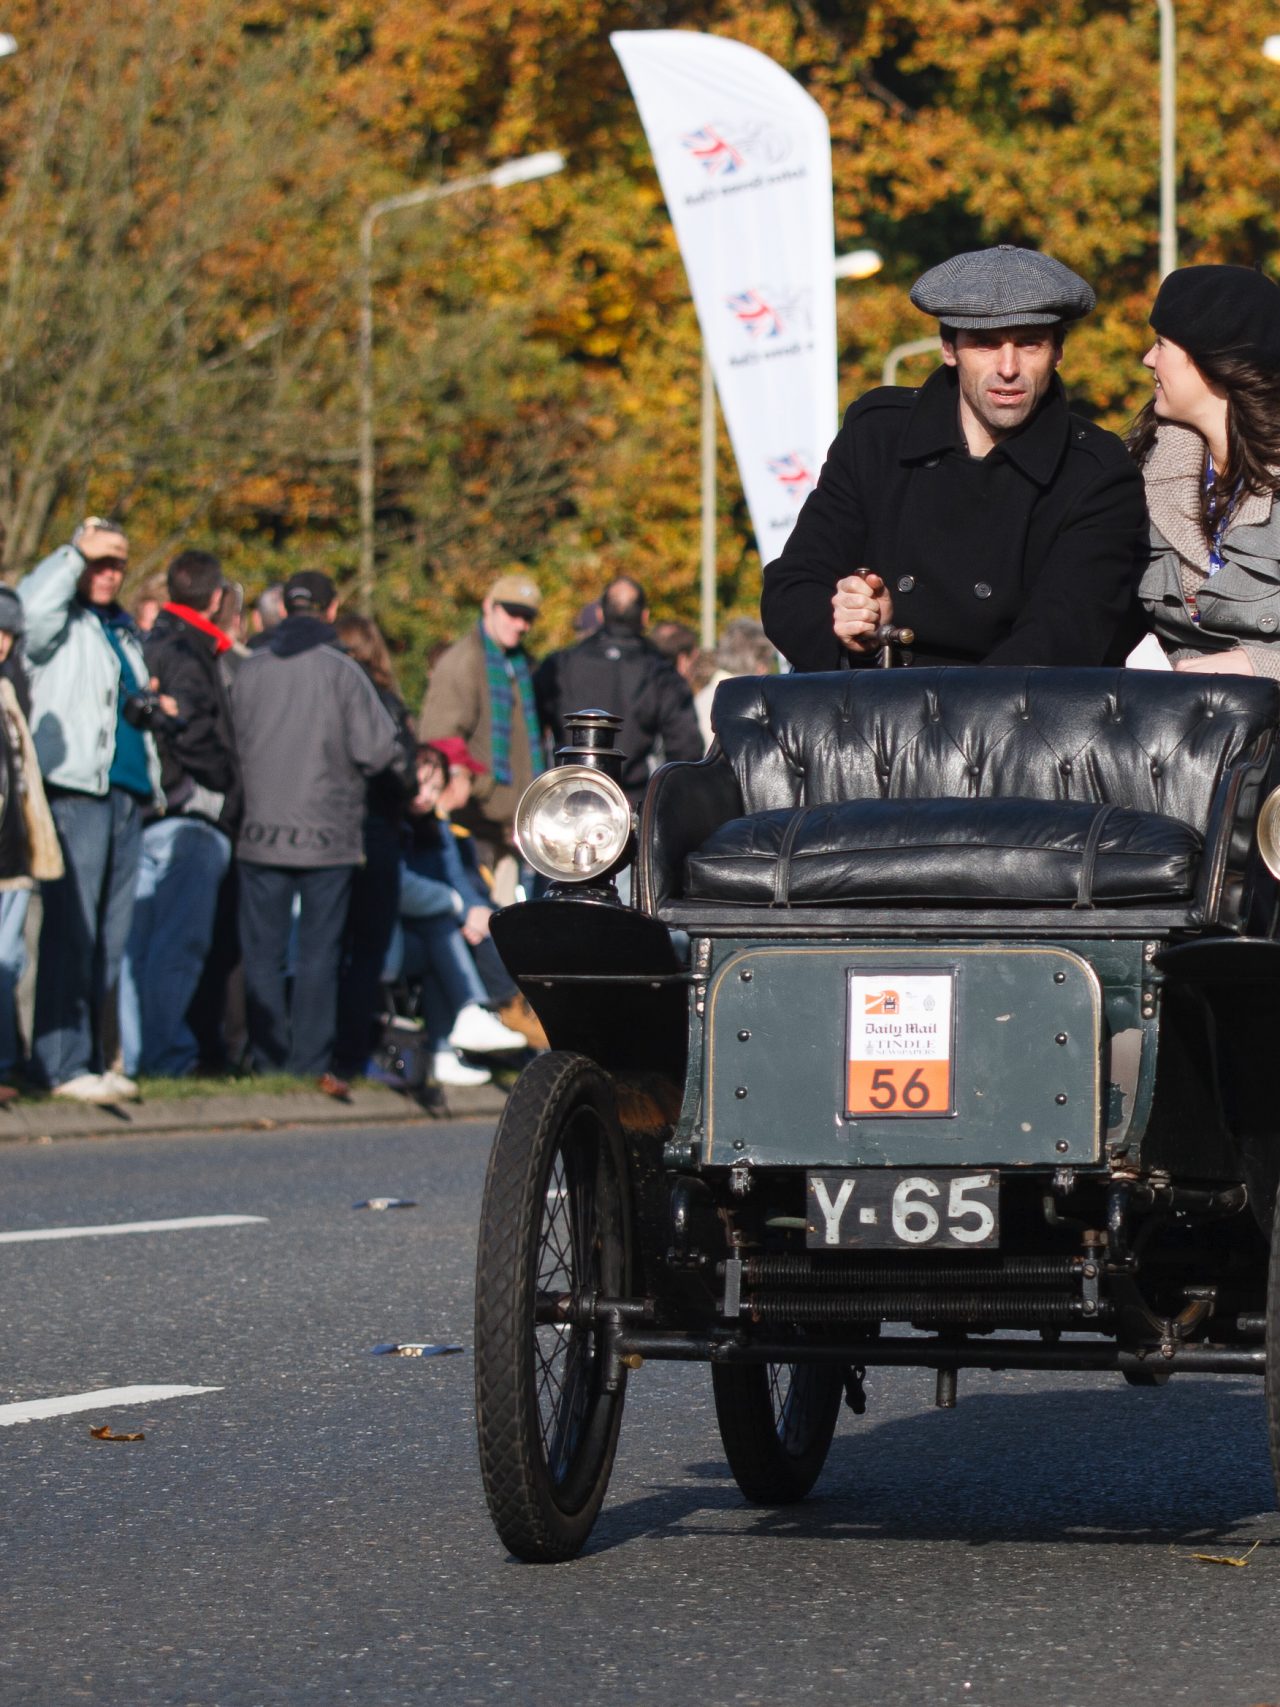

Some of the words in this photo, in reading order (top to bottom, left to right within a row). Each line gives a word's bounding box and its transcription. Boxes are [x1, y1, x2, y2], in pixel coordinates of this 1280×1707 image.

[865, 1023, 902, 1037] Daily
[905, 1023, 937, 1034] Mail
[875, 1040, 934, 1048] TINDLE
[869, 1068, 930, 1109] 56
